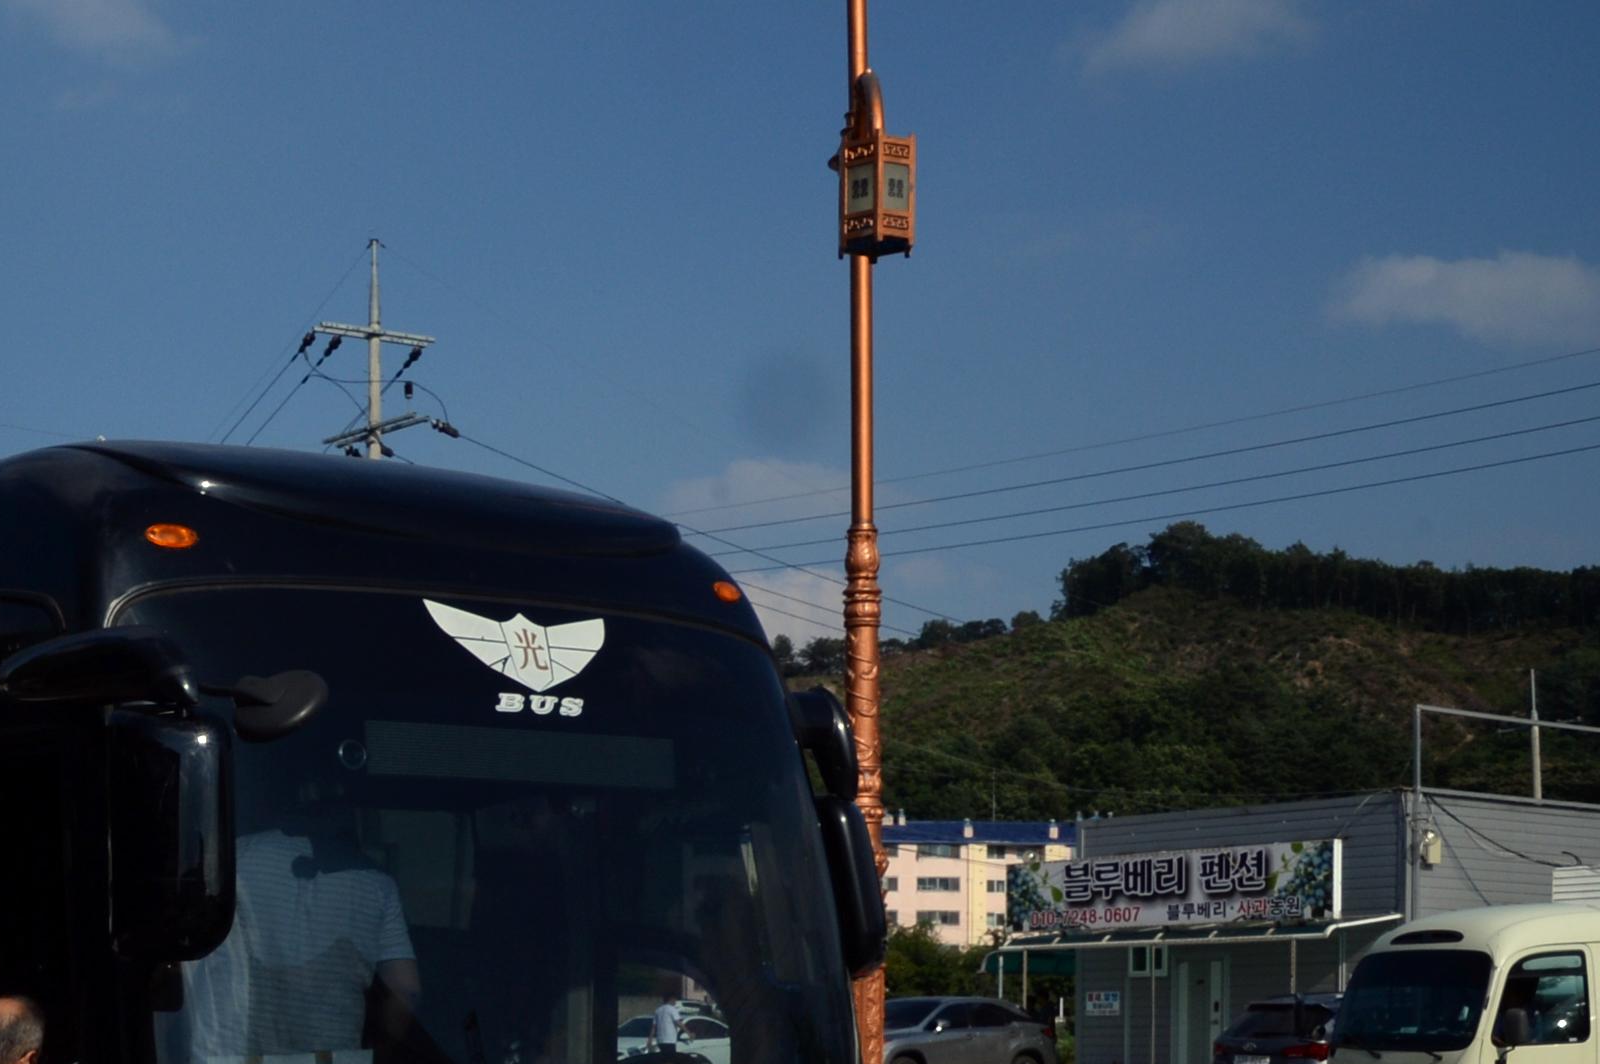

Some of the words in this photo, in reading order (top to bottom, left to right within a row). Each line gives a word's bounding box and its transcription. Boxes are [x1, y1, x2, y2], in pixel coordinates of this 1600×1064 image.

[513, 628, 549, 671] 光
[494, 691, 585, 717] BUS
[1063, 856, 1186, 901] 블루베리
[1199, 849, 1267, 892] 펜션
[1030, 907, 1141, 928] 010-7248-0607
